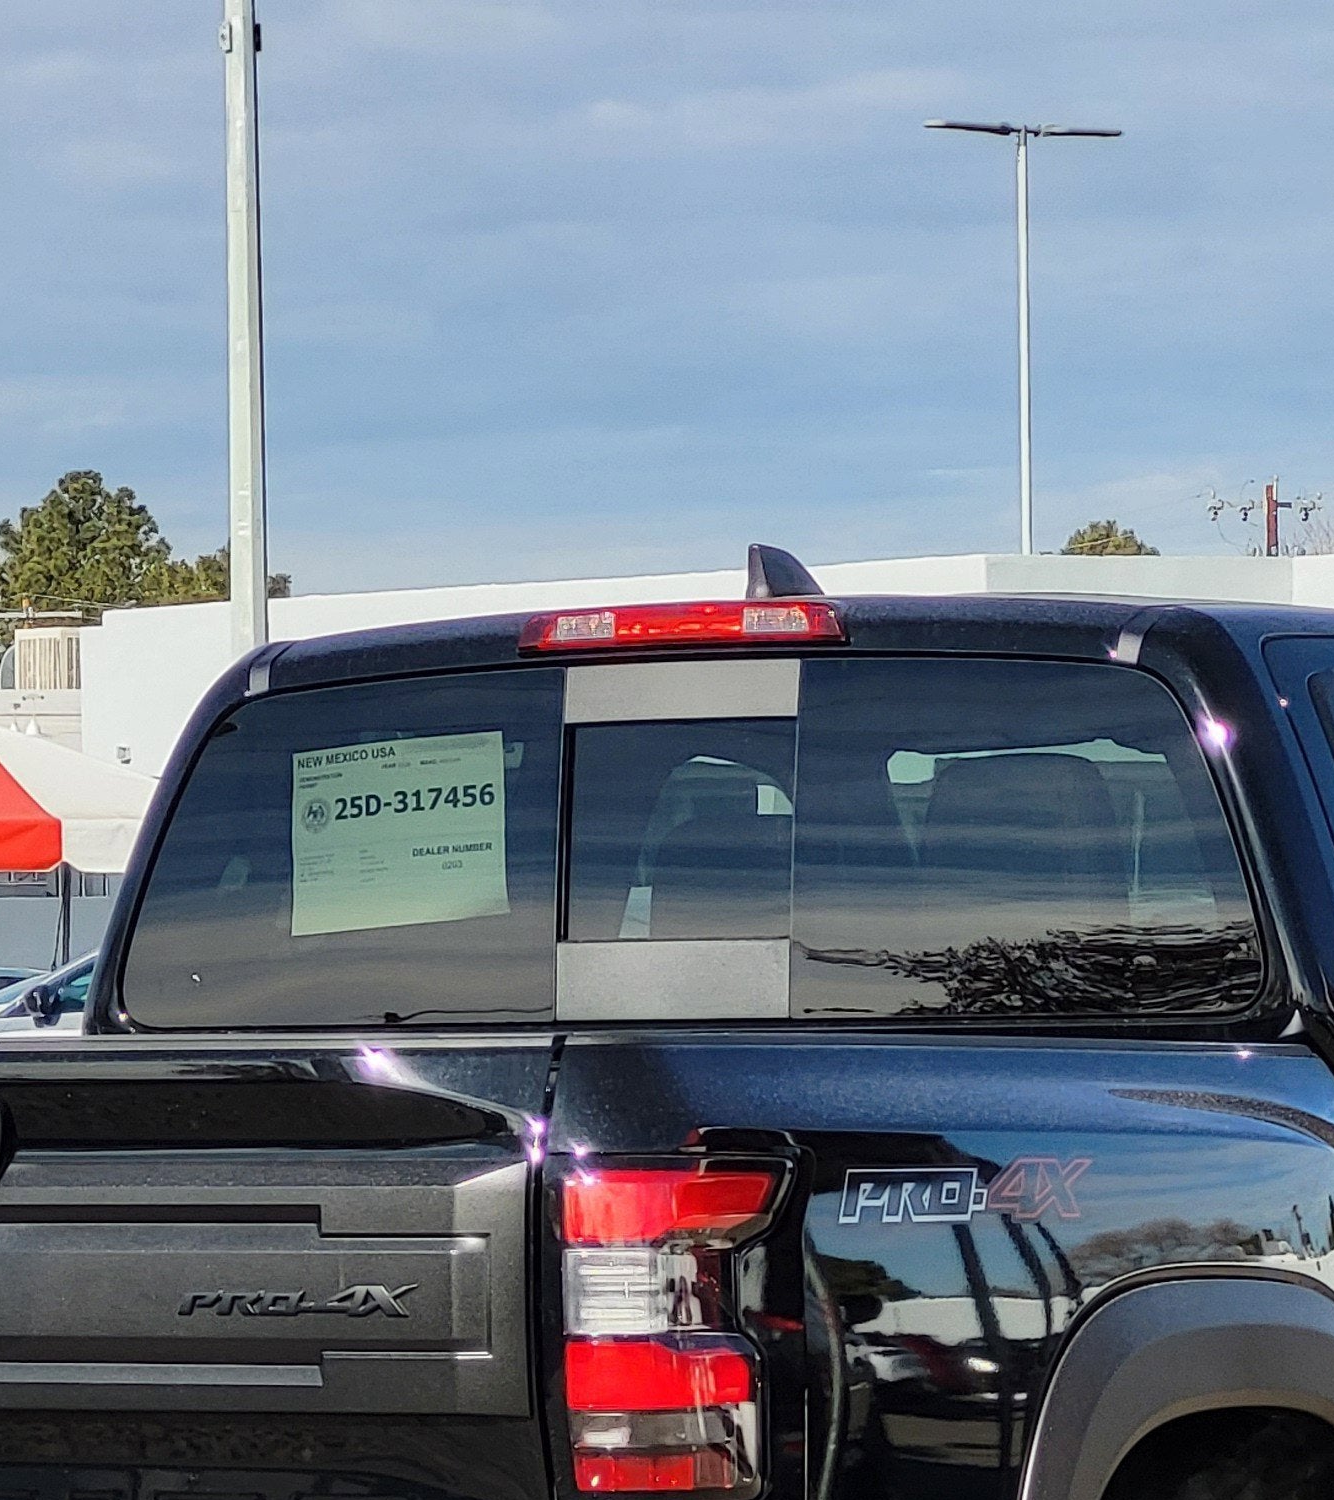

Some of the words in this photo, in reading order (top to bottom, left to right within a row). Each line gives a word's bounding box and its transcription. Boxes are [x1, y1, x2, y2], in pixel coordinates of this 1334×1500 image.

[297, 757, 323, 770] NEW
[325, 750, 369, 766] MEXICO
[371, 746, 396, 759] USA
[334, 783, 496, 821] 25D-317456
[412, 845, 450, 857] DEALER
[452, 842, 493, 853] NUMBER
[838, 1157, 1093, 1225] PRO-4X
[177, 1283, 419, 1318] PRO-4X
